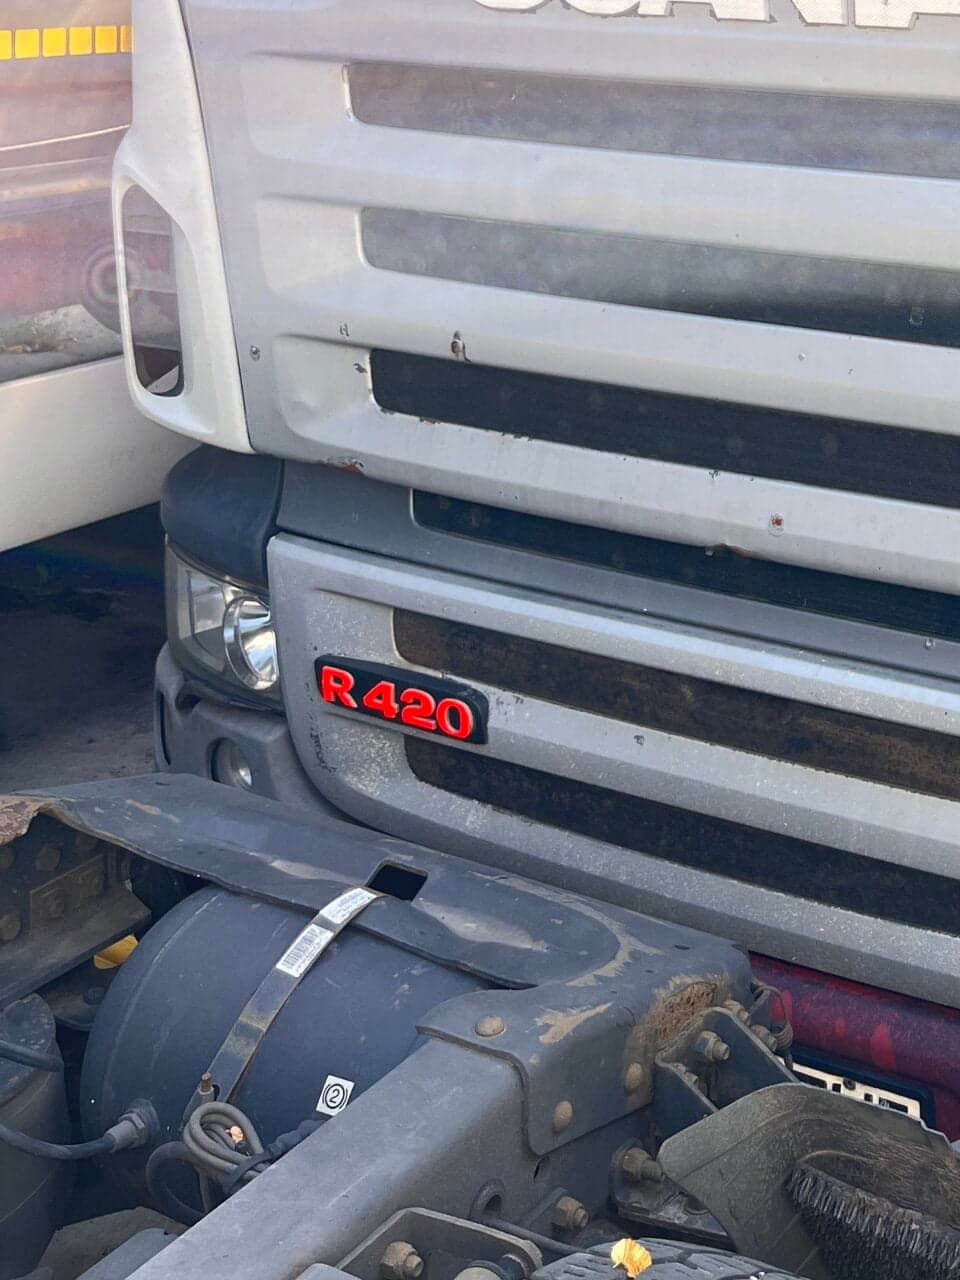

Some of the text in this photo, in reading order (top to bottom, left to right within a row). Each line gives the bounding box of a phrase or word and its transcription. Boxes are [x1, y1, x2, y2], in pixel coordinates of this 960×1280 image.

[321, 665, 474, 740] R 420
[329, 1088, 340, 1104] 2
